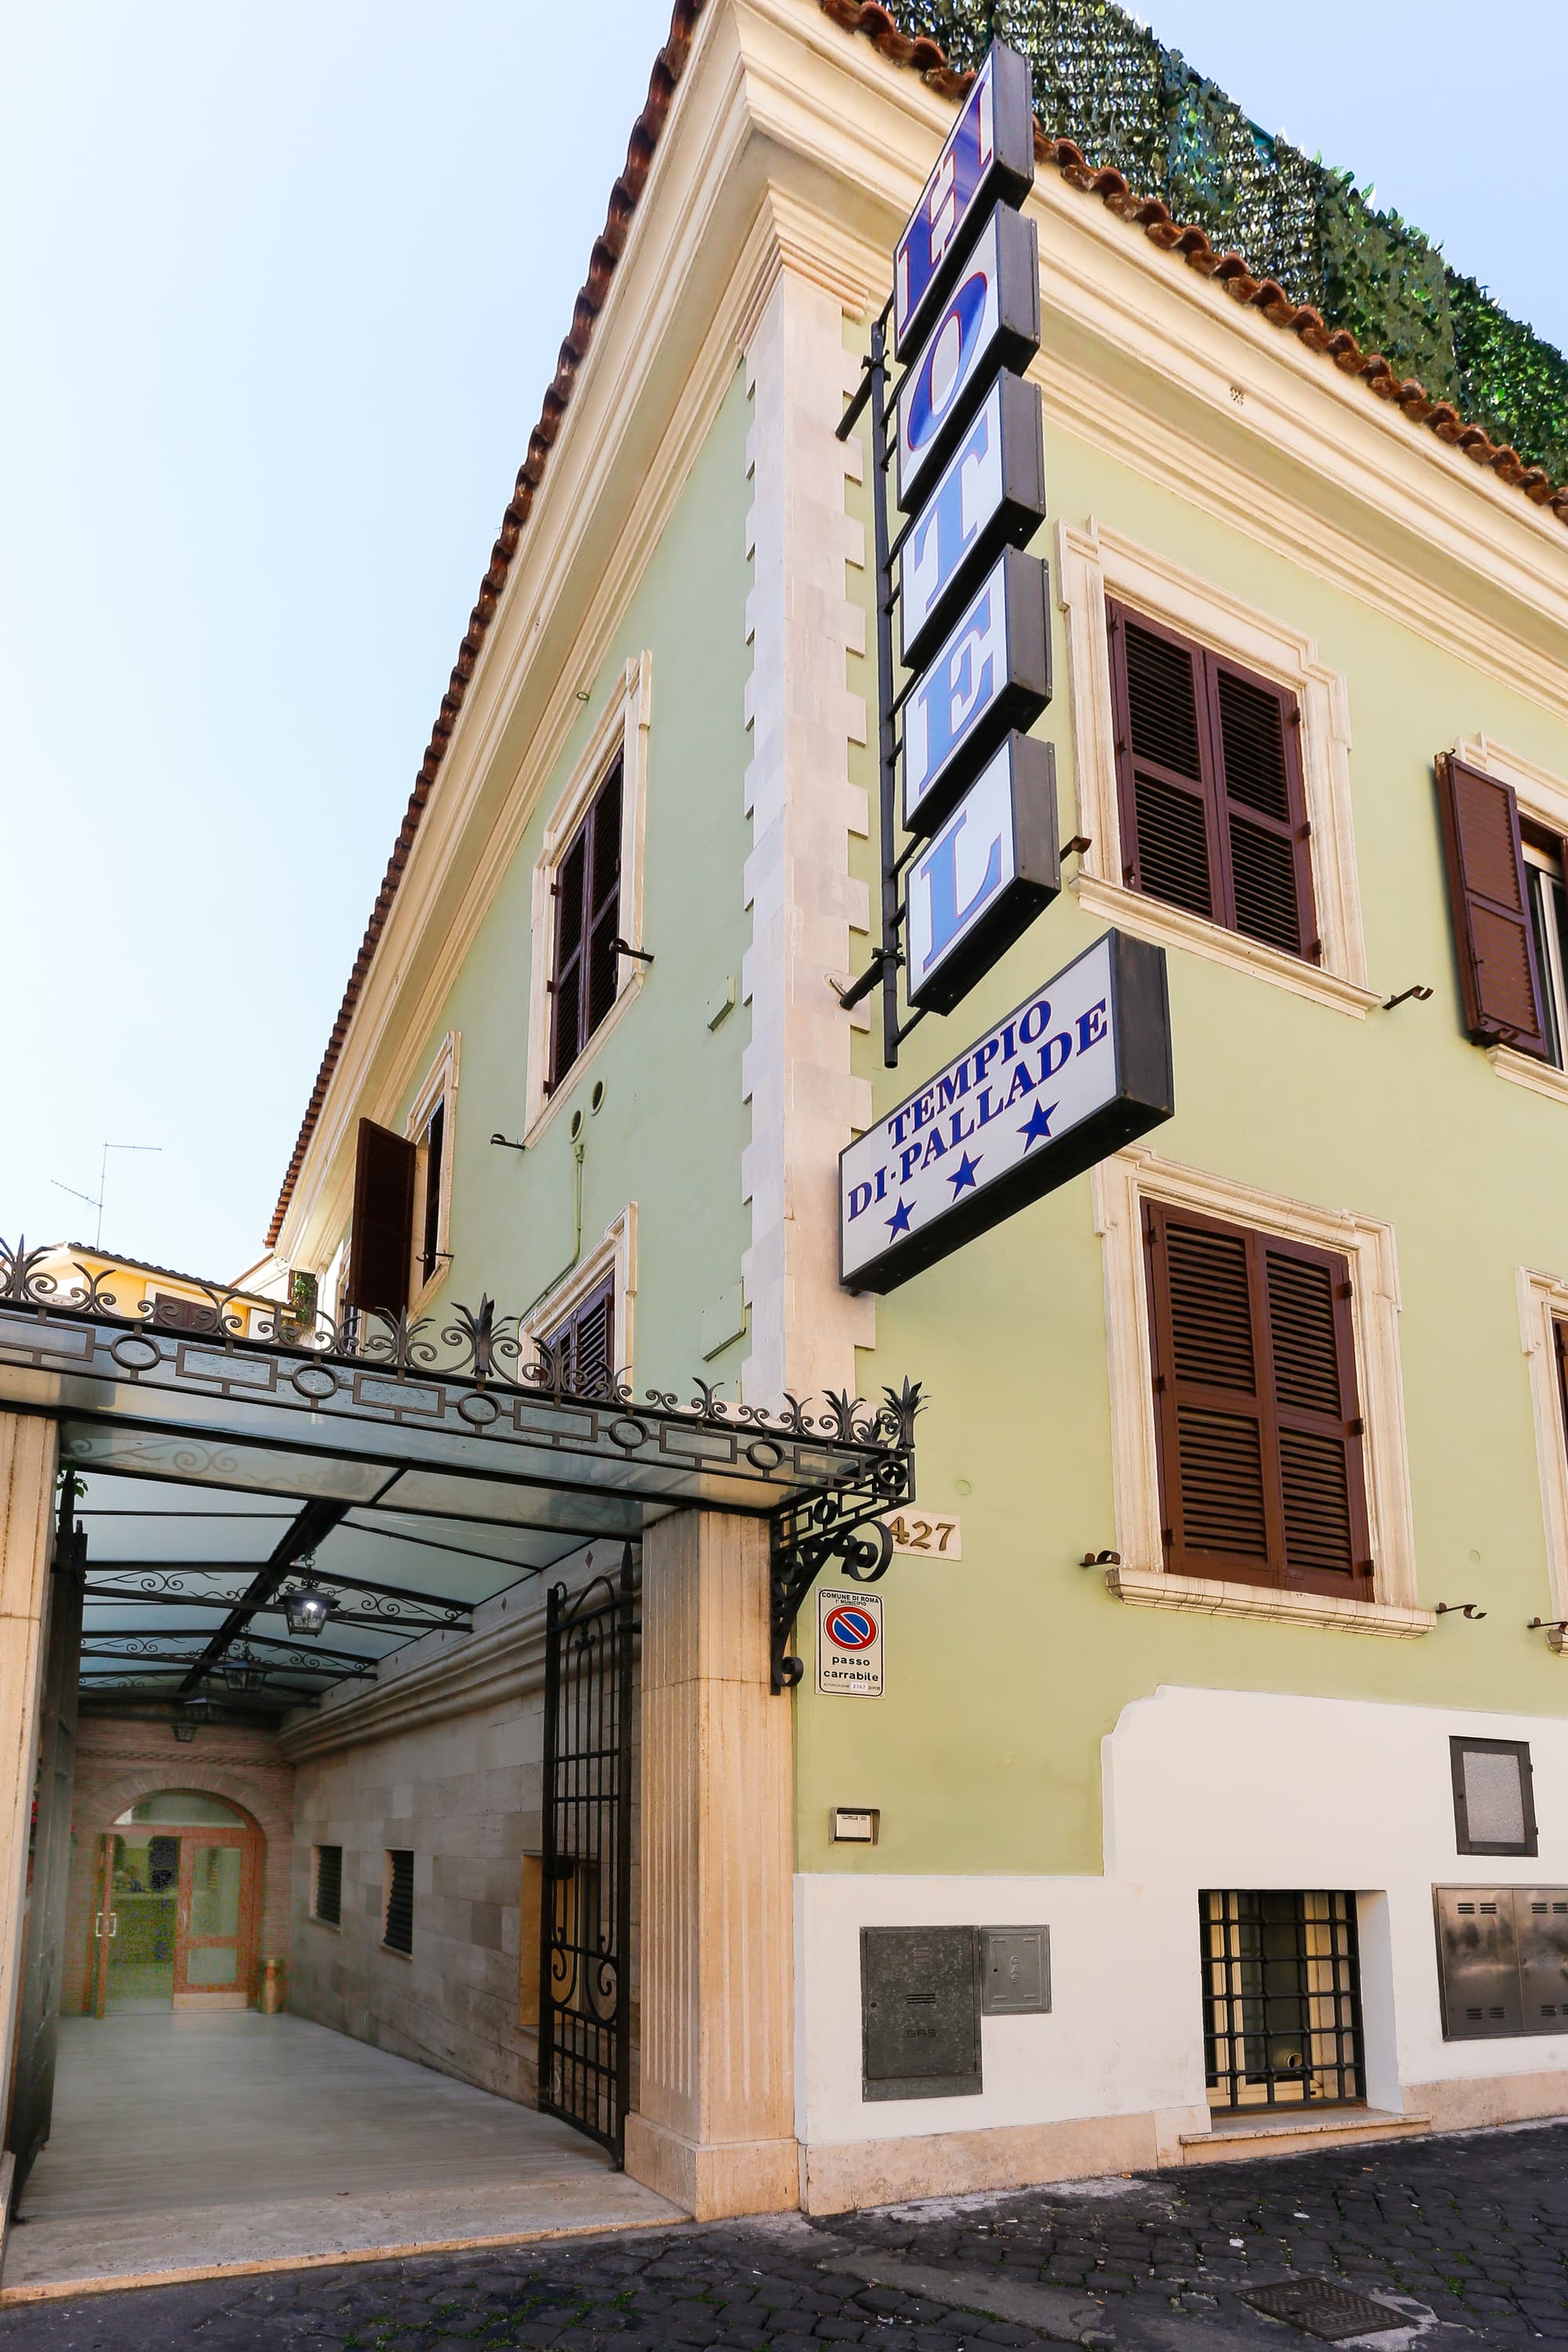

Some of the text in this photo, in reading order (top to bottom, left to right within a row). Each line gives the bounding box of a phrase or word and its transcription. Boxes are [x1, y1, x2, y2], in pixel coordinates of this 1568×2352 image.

[898, 67, 1002, 974] HOTEL
[887, 1000, 1052, 1149] TEMPIO
[887, 1515, 956, 1551] 427
[822, 1592, 851, 1600] COMUNE
[832, 1656, 870, 1667] passo
[823, 1670, 879, 1682] carrabile
[1010, 1955, 1021, 1986] GAS
[907, 2028, 936, 2038] GAS
